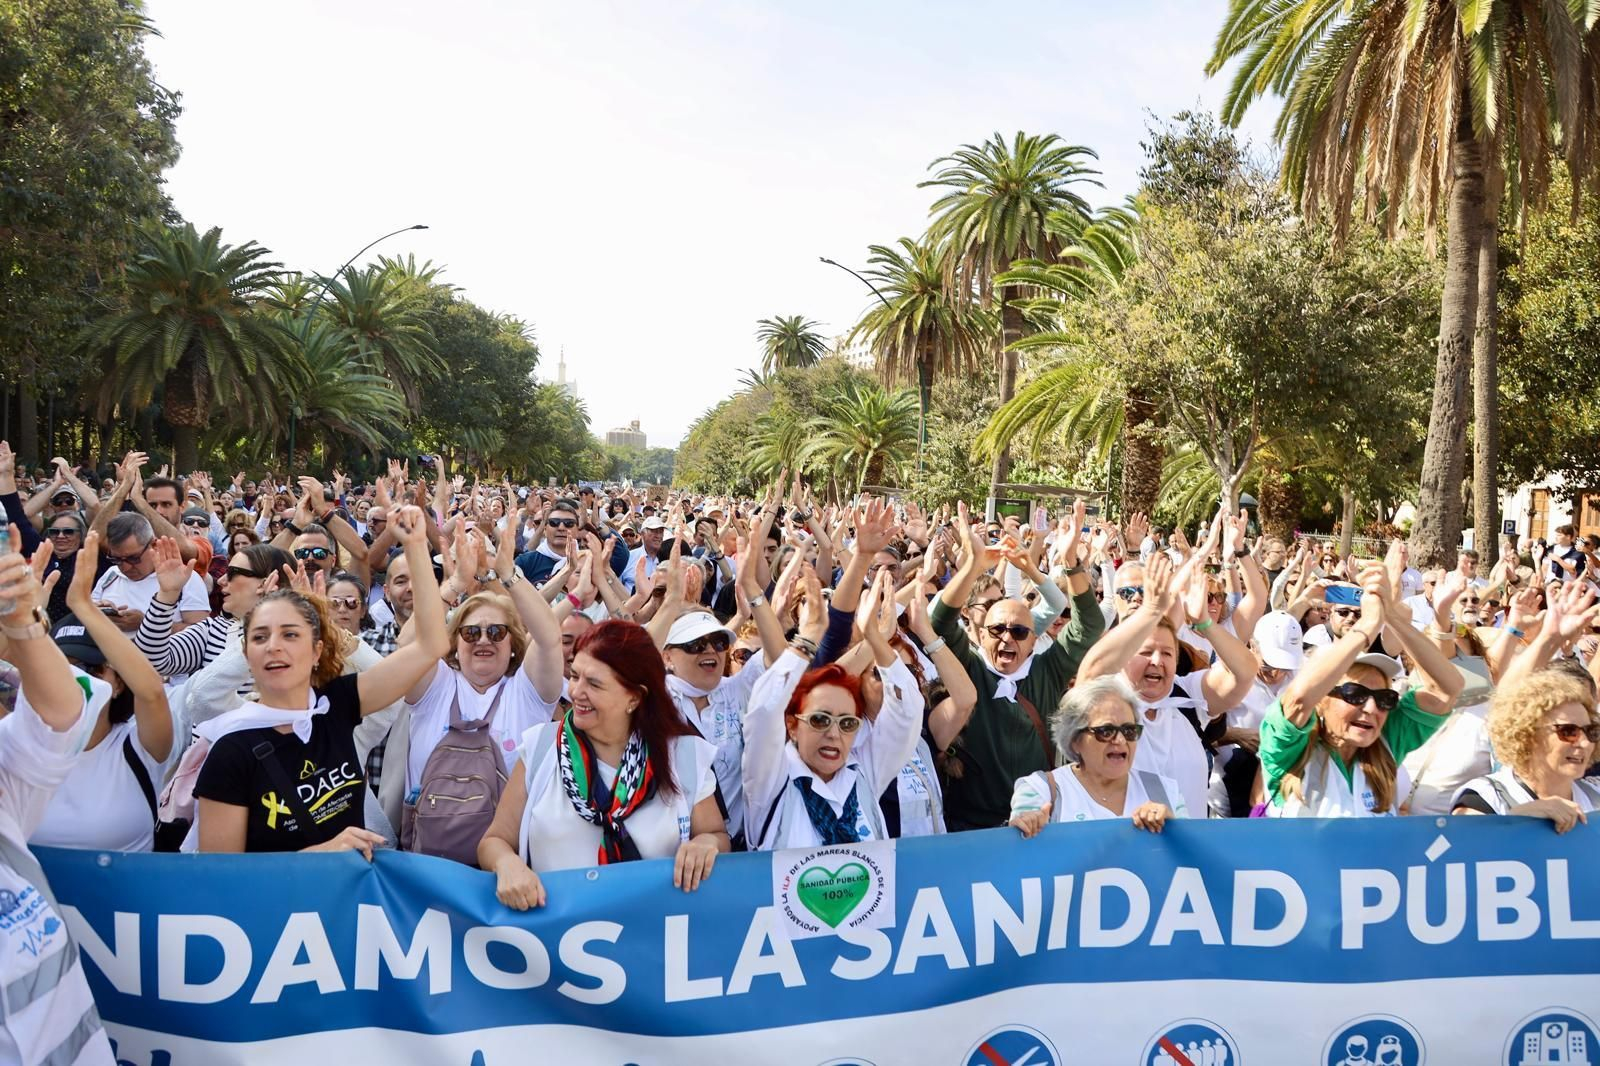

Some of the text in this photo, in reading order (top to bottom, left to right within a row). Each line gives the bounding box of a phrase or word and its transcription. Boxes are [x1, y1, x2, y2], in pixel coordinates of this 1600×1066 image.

[296, 762, 356, 804] DAEC
[816, 848, 851, 857] MAREAS
[799, 854, 816, 866] LAS
[851, 850, 882, 876] BLANCAS
[789, 864, 801, 876] DE
[800, 879, 835, 889] SANIDAD
[876, 876, 885, 889] DE
[781, 892, 789, 904] LA
[822, 888, 854, 901] 100%
[665, 905, 807, 1003] LA
[830, 866, 1308, 981] SANIDAD
[1340, 834, 1600, 950] PÚBL
[783, 904, 821, 933] APOYAMOS
